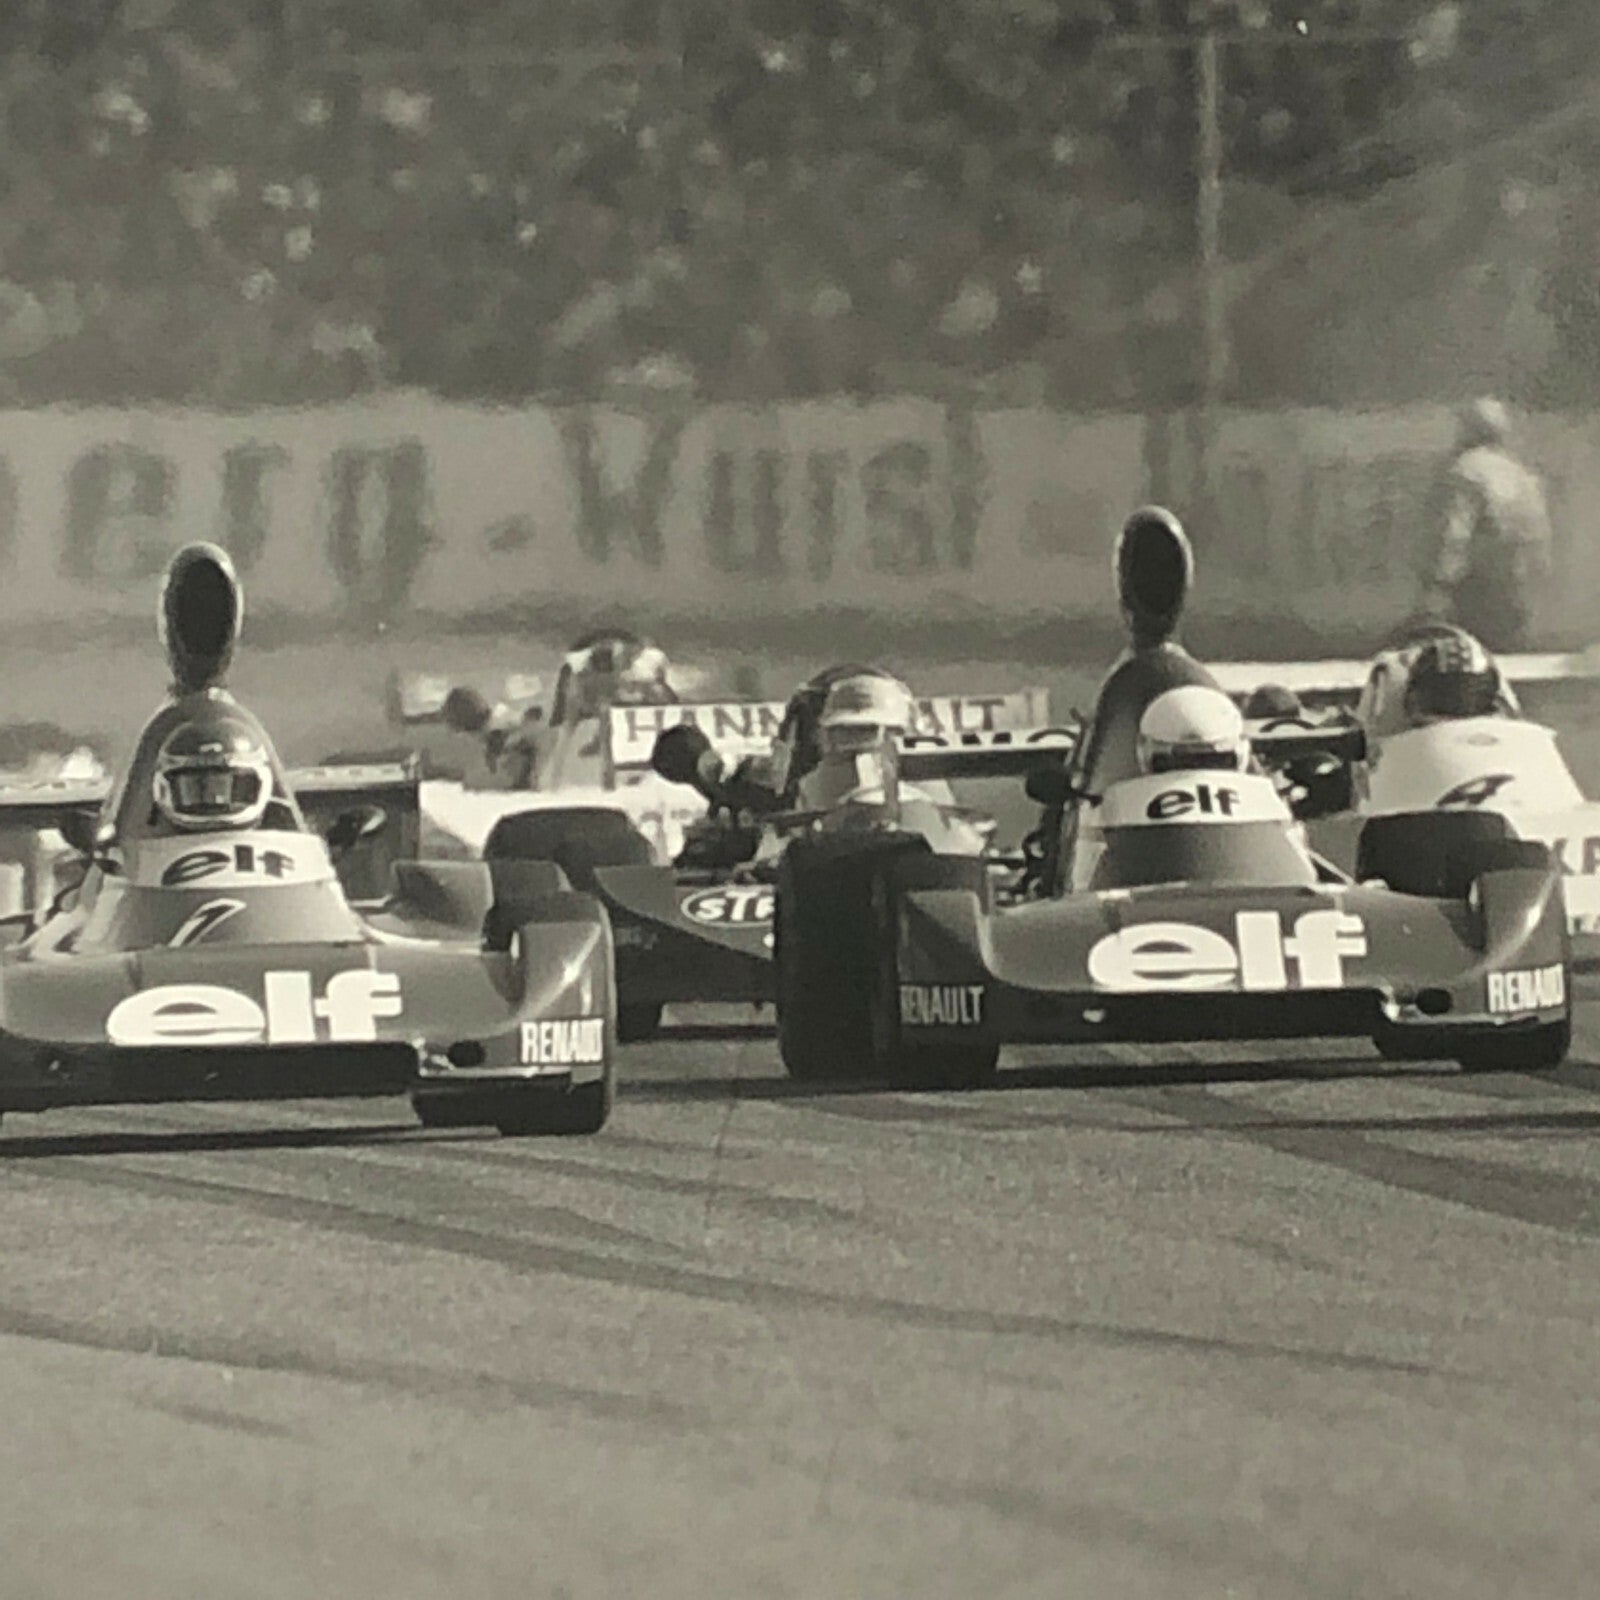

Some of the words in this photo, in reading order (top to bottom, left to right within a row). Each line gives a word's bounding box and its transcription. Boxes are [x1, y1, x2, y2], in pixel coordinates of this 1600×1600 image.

[1145, 783, 1242, 820] elf
[160, 844, 295, 887] elf
[1086, 909, 1368, 994] elf
[106, 969, 403, 1047] elf
